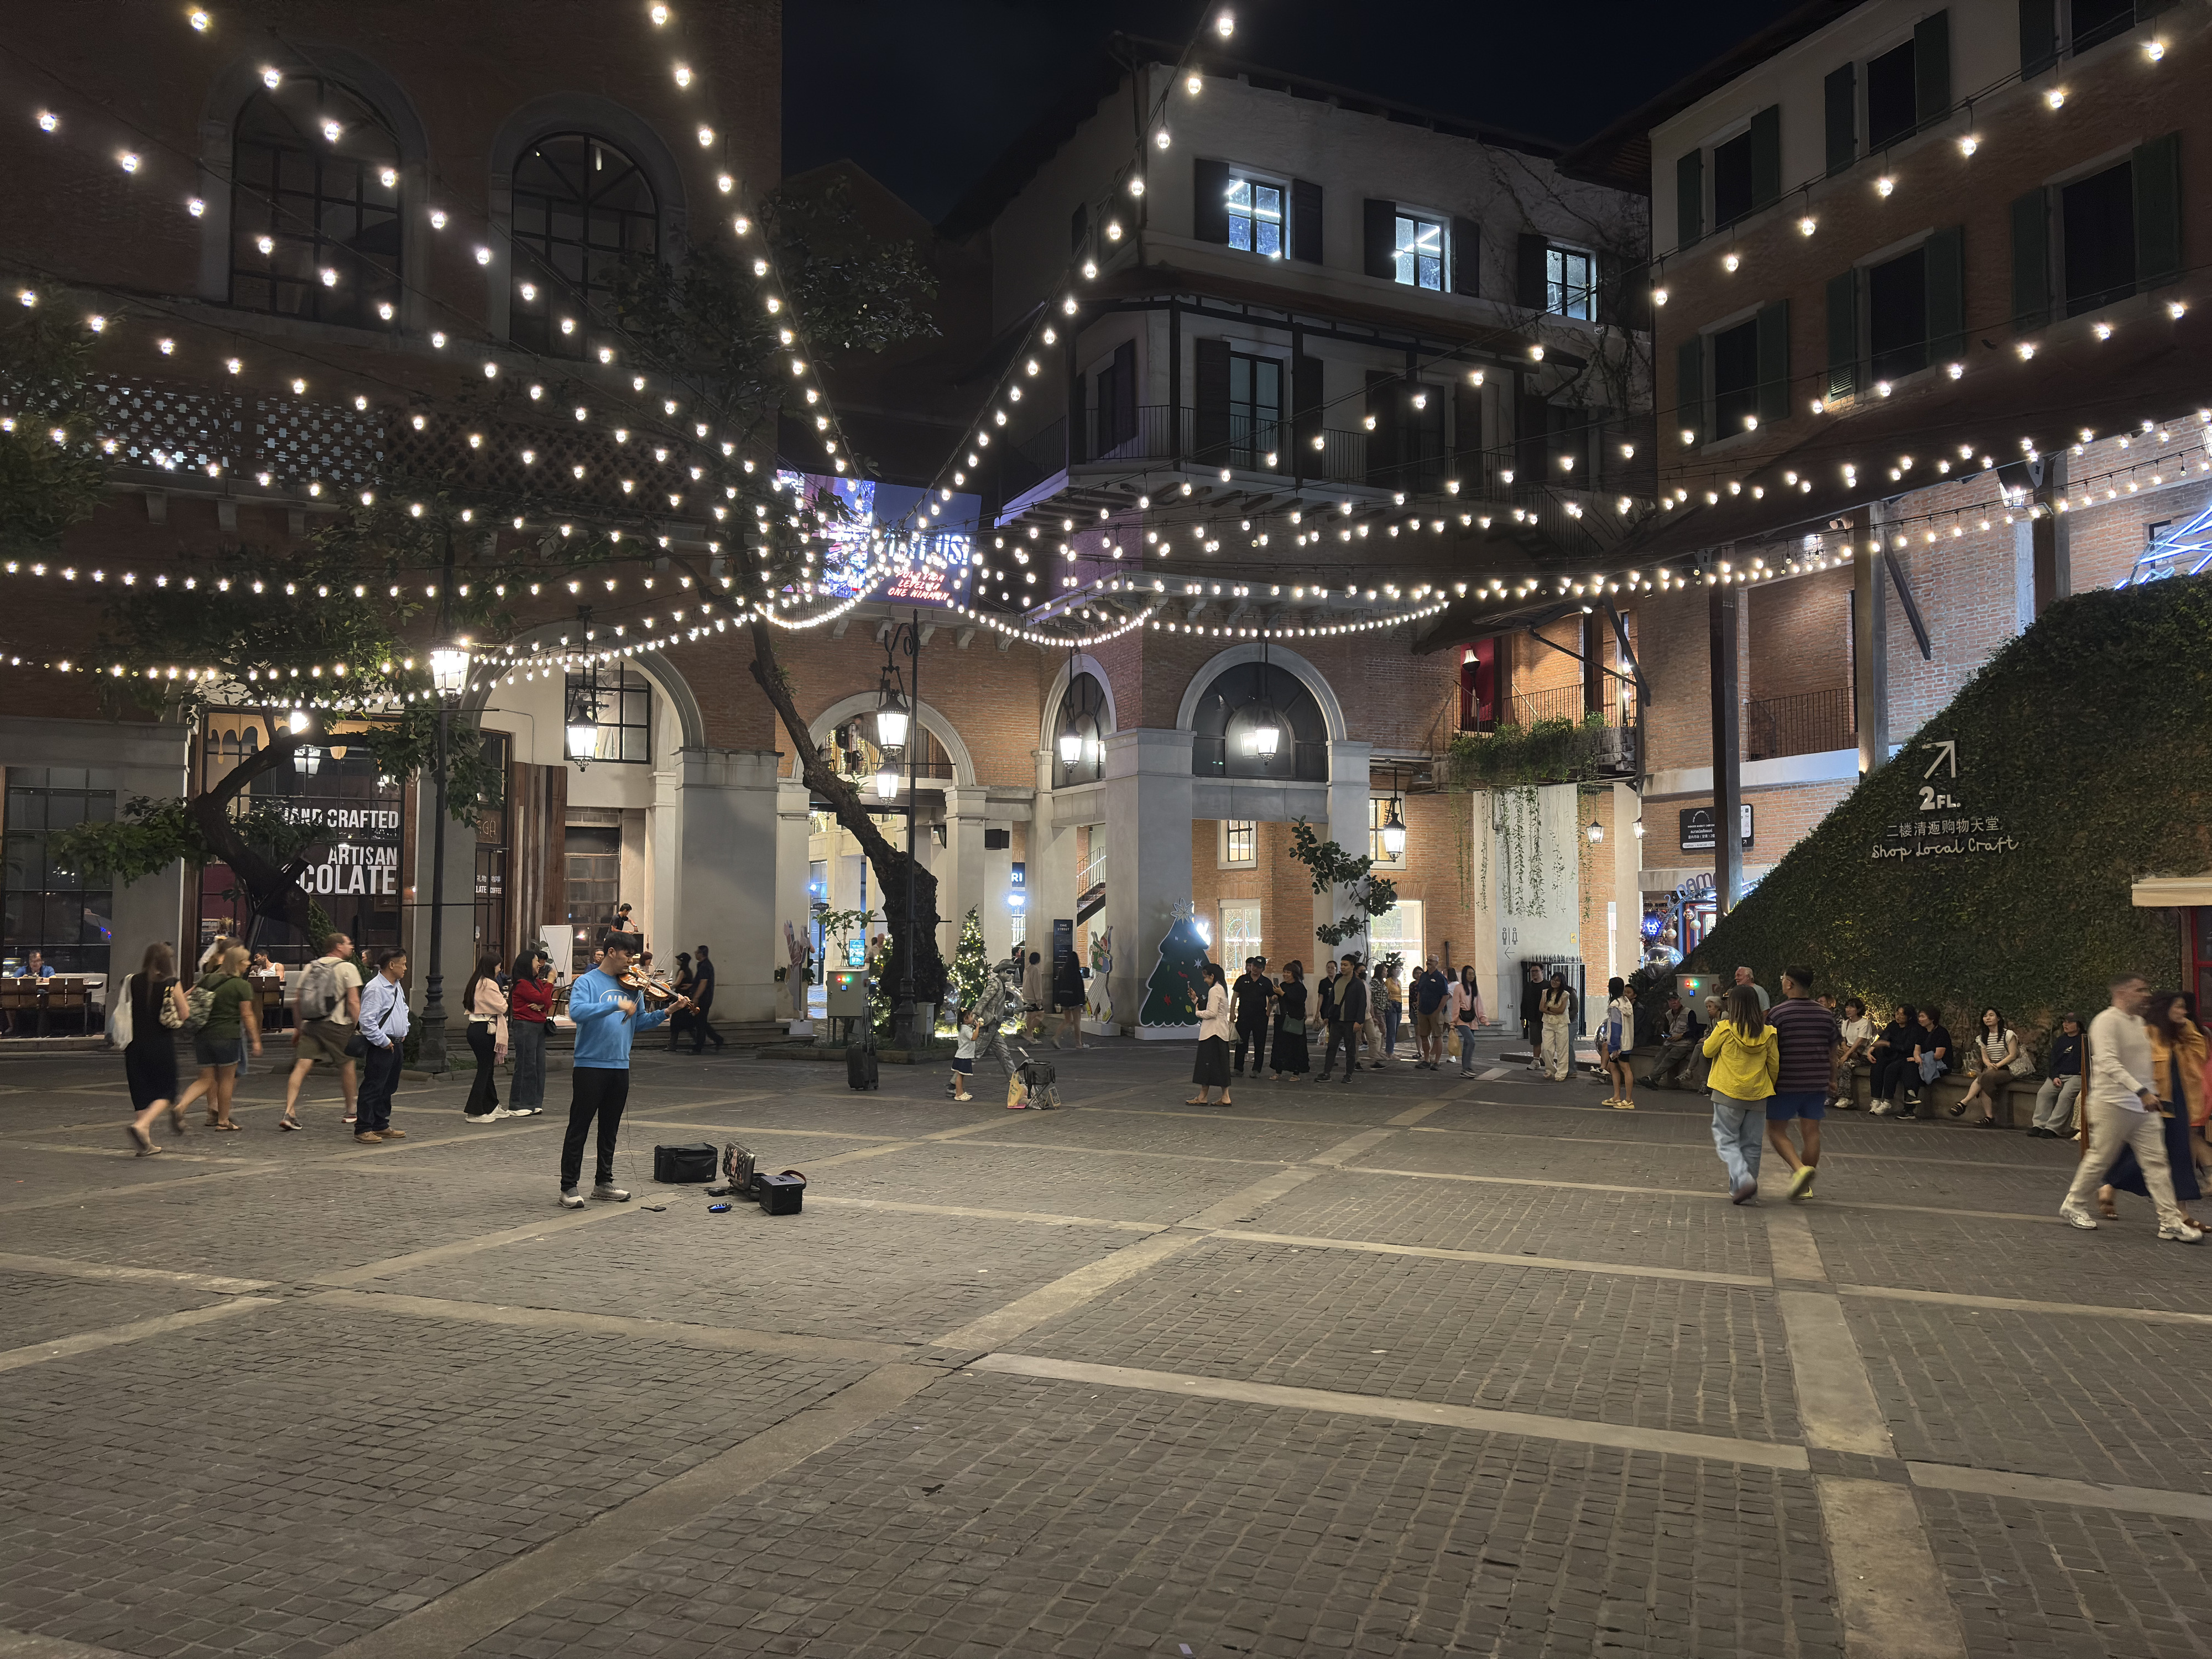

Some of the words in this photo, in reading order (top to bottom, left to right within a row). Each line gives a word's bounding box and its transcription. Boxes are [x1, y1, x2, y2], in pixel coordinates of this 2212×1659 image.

[888, 587, 908, 597] ONE
[327, 809, 398, 828] CRAFTED
[1886, 815, 2000, 838] 二楼清迈购物天堂
[327, 846, 398, 865] ARTISAN
[1871, 844, 1913, 862] Shop
[1916, 838, 1964, 857] Local
[1968, 835, 2020, 853] Craft
